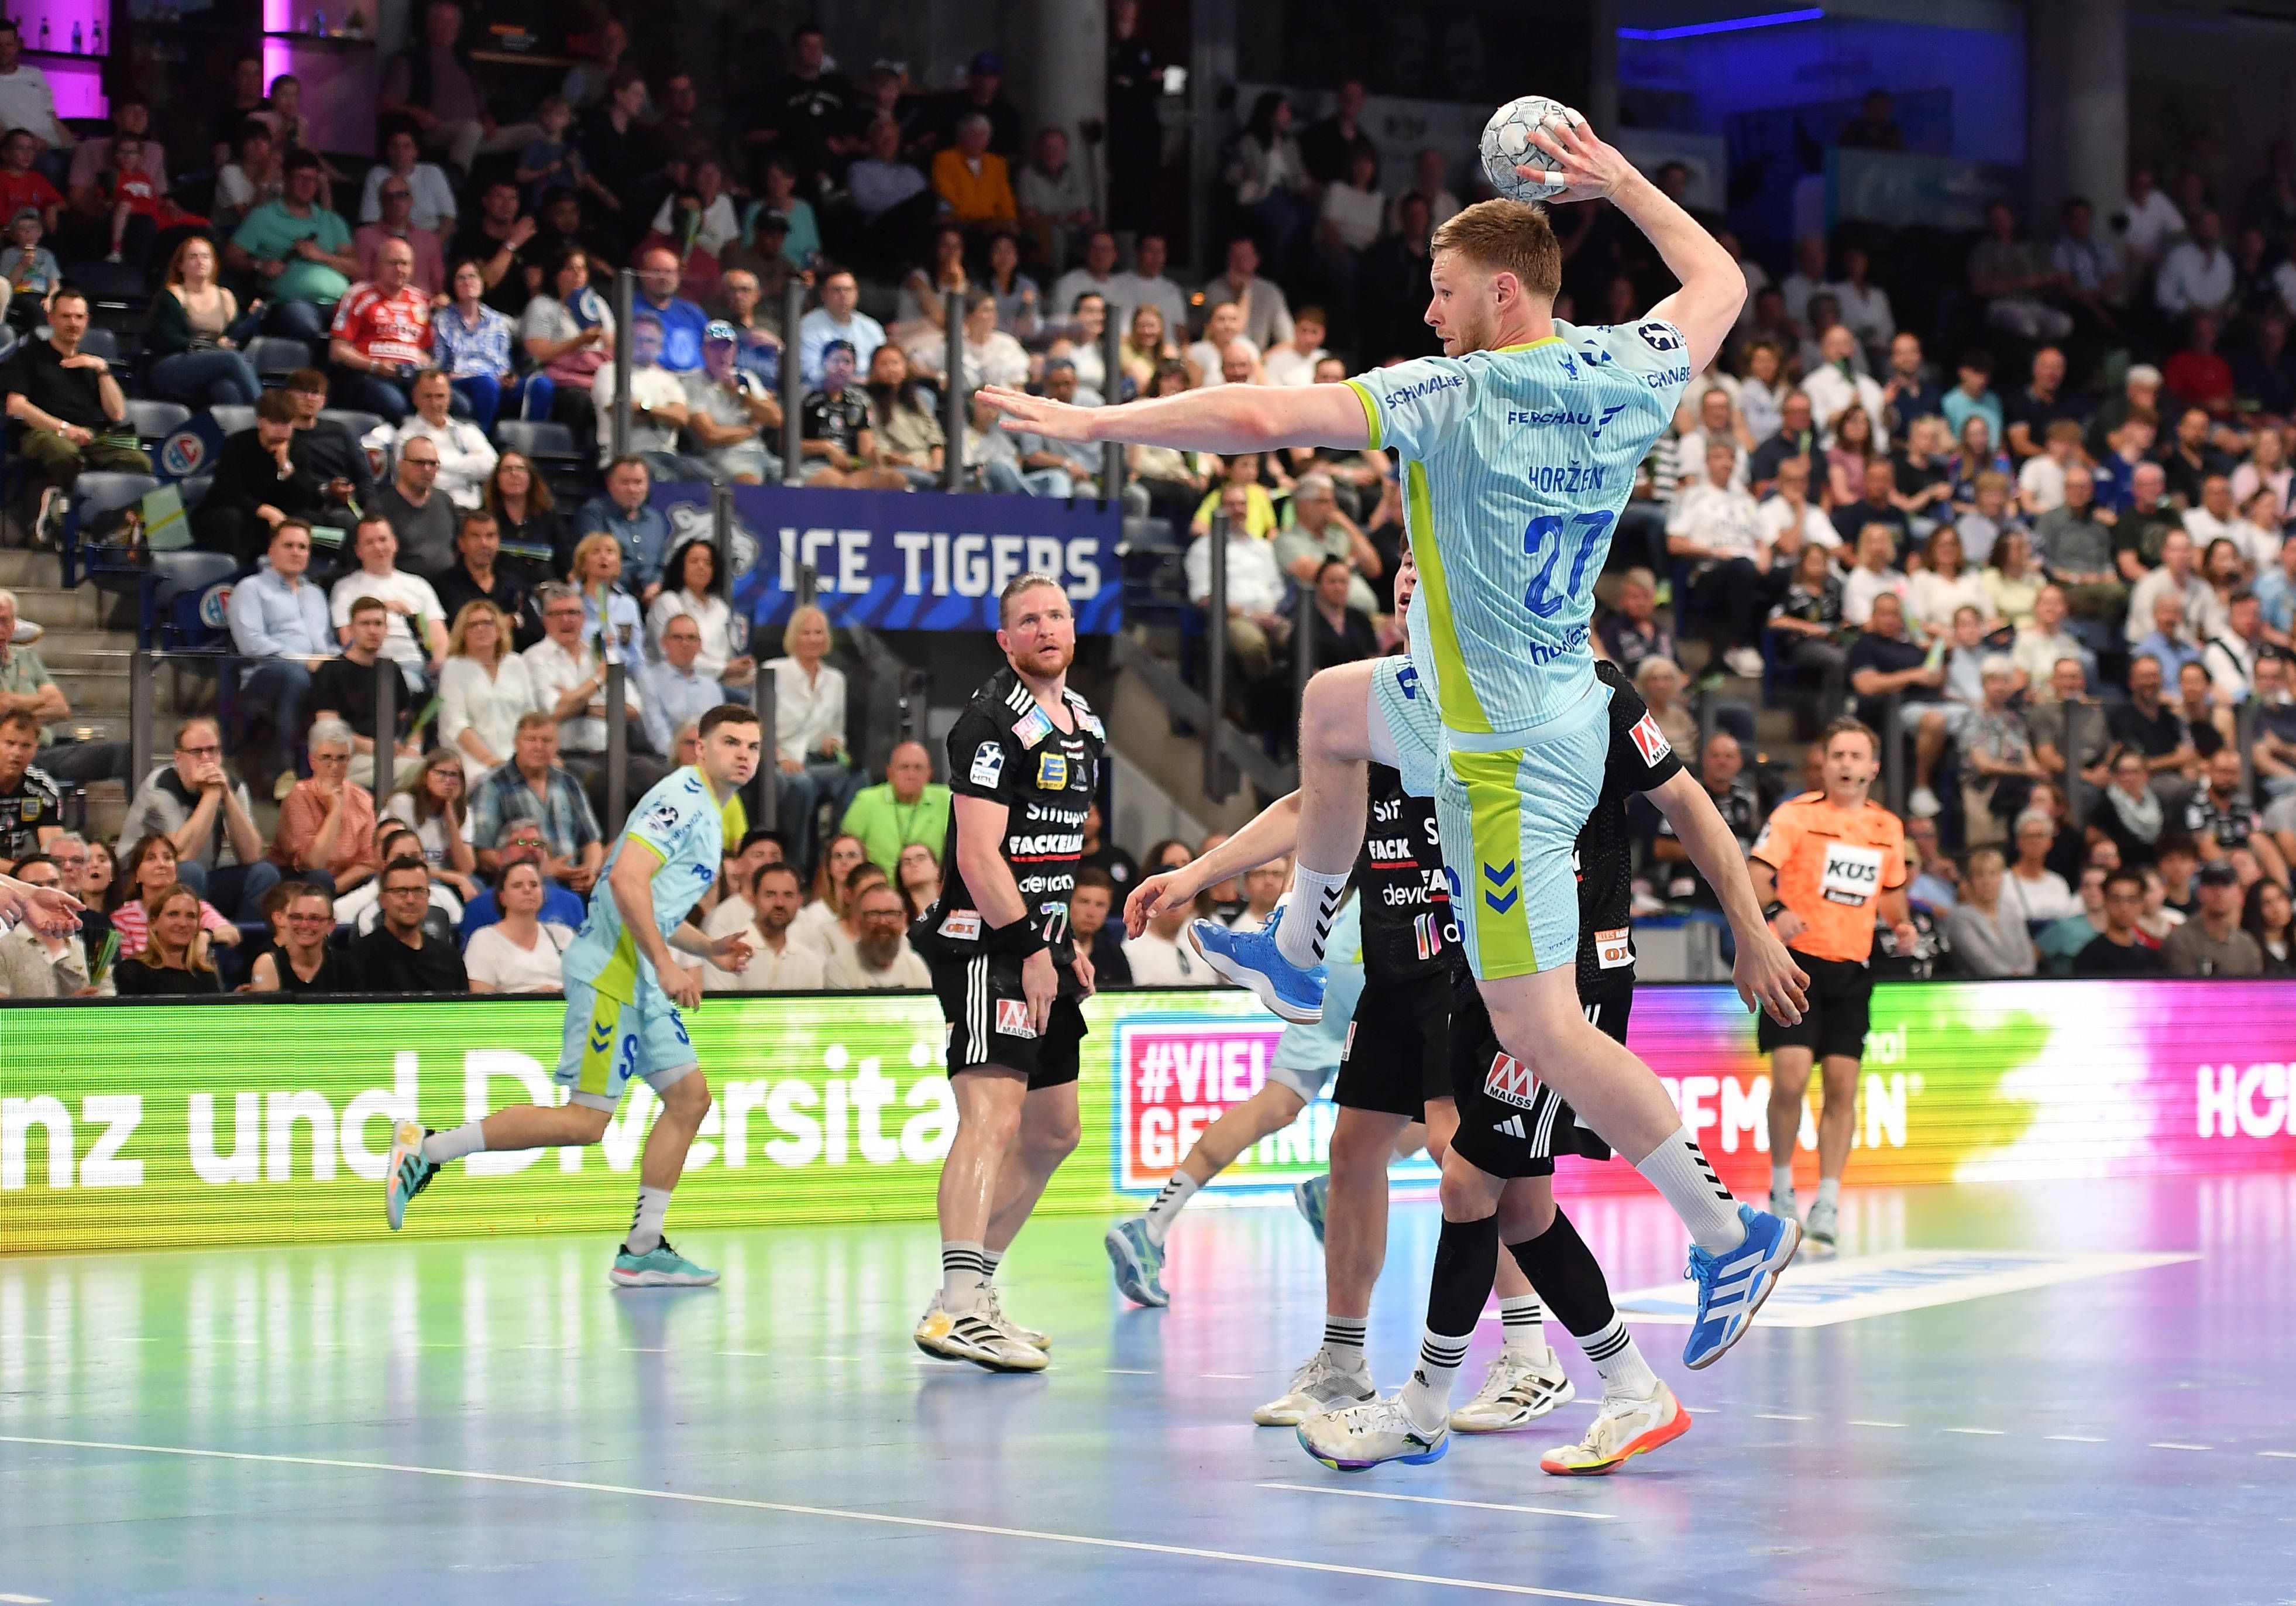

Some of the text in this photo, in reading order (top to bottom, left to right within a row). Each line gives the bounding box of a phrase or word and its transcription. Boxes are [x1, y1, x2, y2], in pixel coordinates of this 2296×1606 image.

[1385, 375, 1464, 410] SCHWALBE
[1507, 411, 1592, 425] FERCHAU
[1528, 459, 1606, 493] HORŽEN
[779, 528, 1101, 600] ICE TIGERS
[1523, 510, 1614, 619] 27
[1367, 838, 1414, 860] FACK
[1382, 883, 1432, 905] devic
[1040, 901, 1068, 944] 77
[1489, 1086, 1532, 1108] MAUSS
[188, 1049, 419, 1183] und
